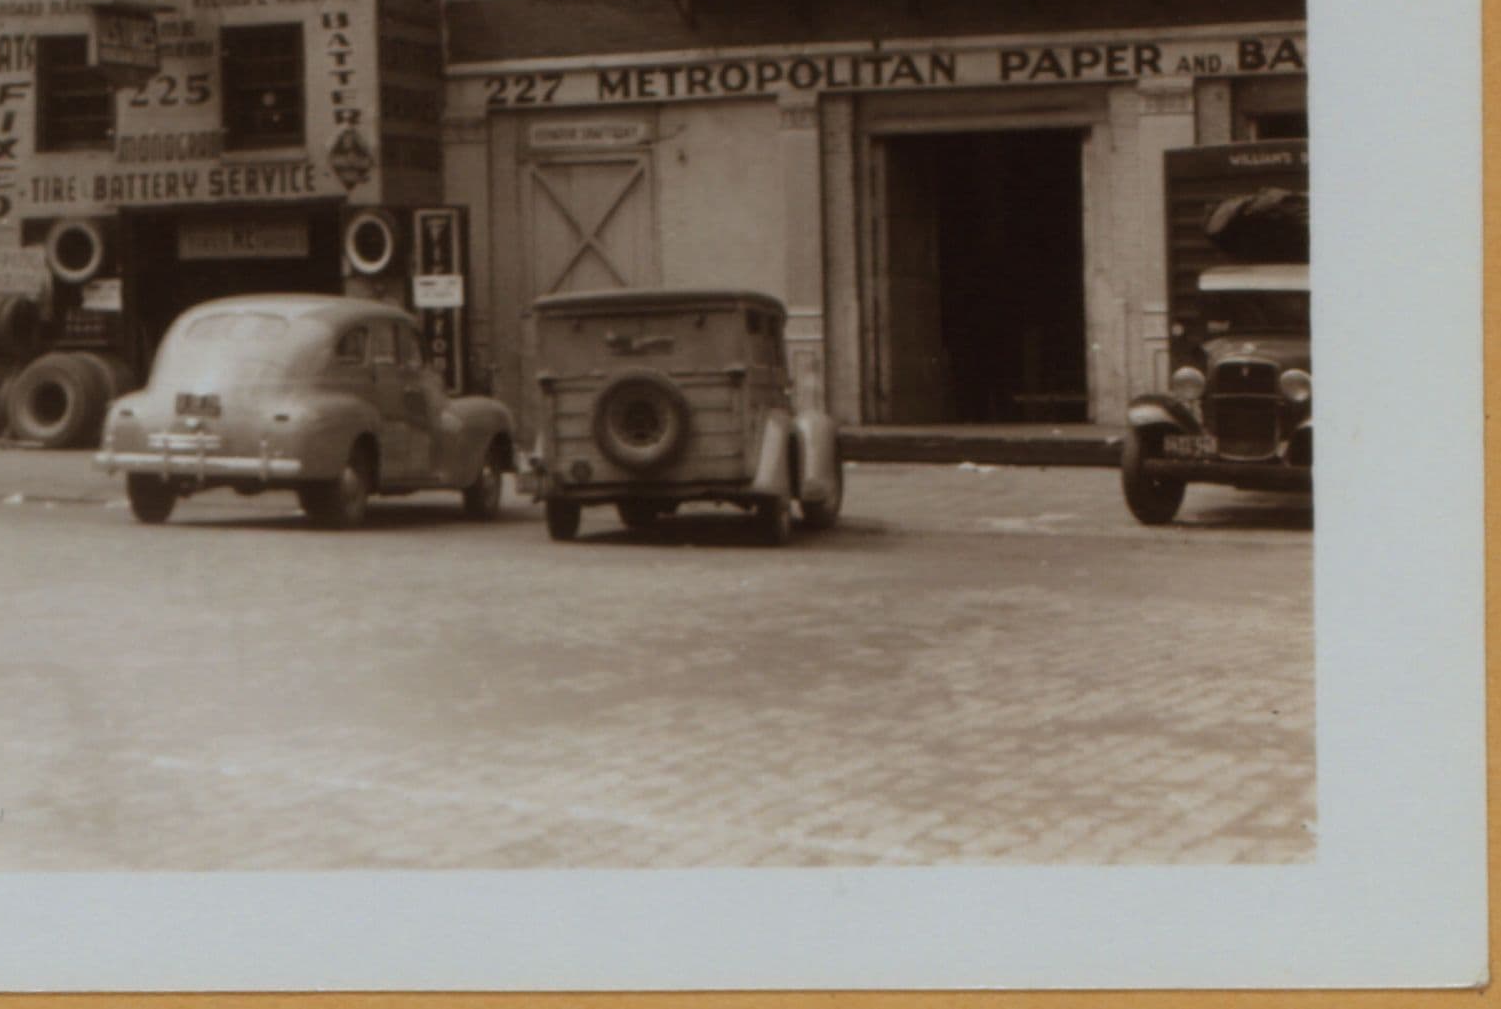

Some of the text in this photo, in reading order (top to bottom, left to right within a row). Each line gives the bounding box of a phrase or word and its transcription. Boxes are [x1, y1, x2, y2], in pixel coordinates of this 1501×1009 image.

[129, 74, 213, 108] 225
[486, 73, 564, 103] 227
[599, 52, 956, 99] METROPOLITAN
[1000, 44, 1162, 80] PAPER
[1177, 54, 1222, 73] AND
[31, 163, 316, 202] TIRE BATTERY SERVICE
